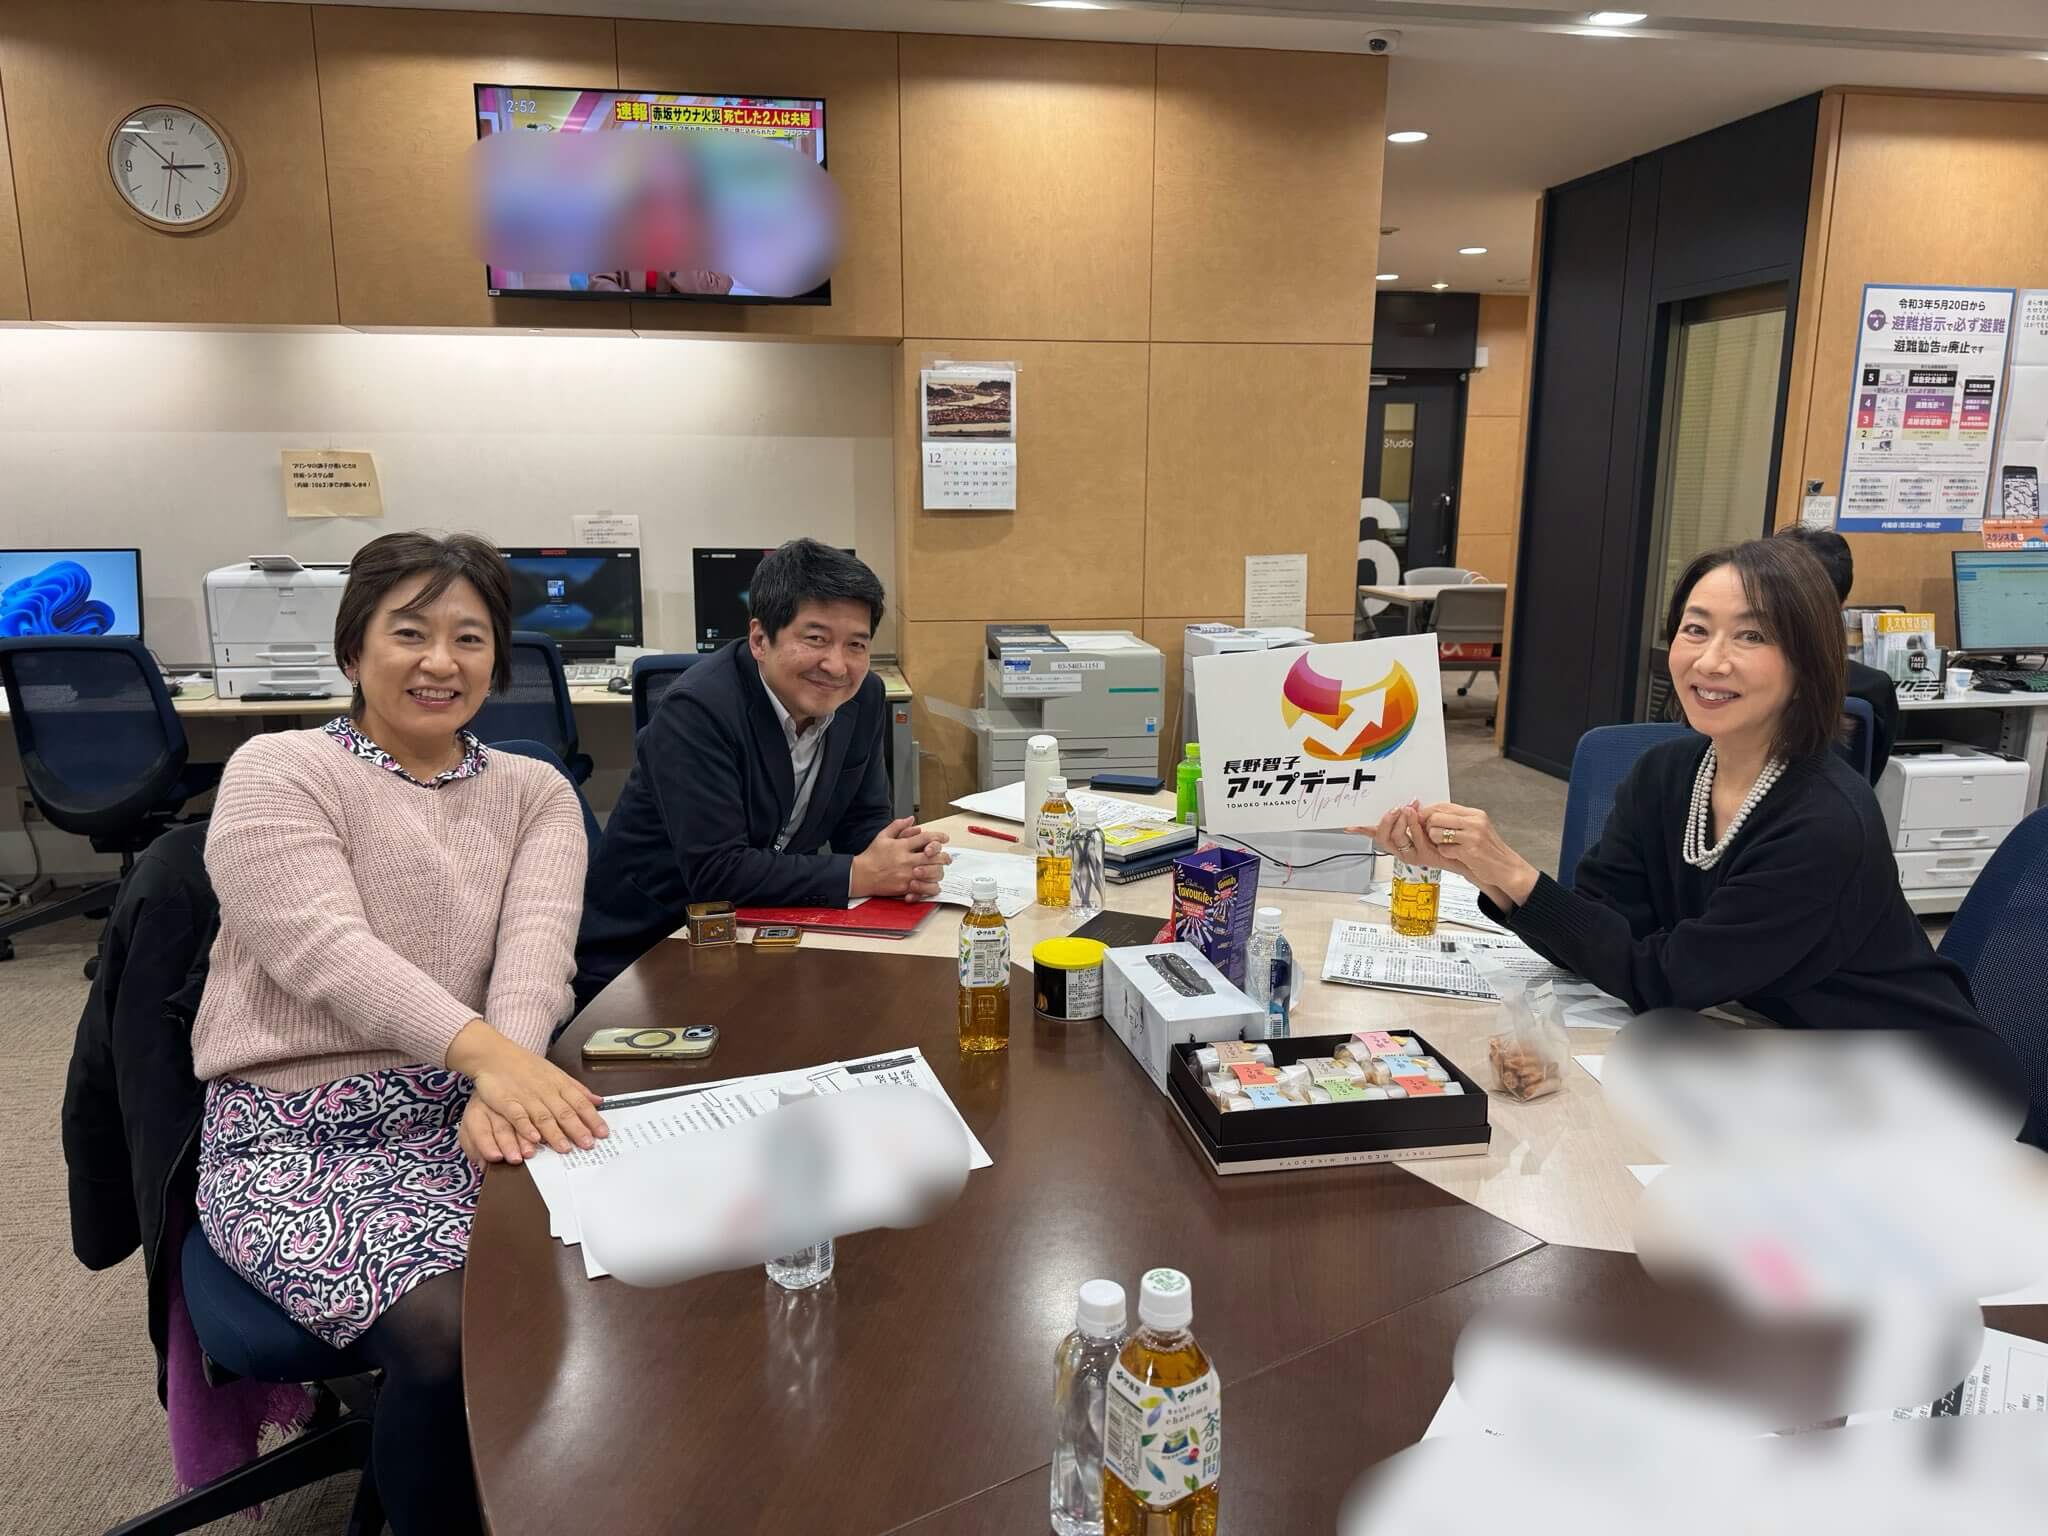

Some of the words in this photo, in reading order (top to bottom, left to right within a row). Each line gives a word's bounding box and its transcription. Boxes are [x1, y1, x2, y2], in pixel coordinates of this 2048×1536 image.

[507, 100, 536, 113] 2:52
[616, 102, 648, 121] 速報
[652, 107, 721, 123] 赤坂サウナ火災
[723, 109, 811, 127] 死亡した2人は夫婦
[164, 118, 174, 131] 12
[125, 160, 132, 172] 9
[213, 162, 221, 174] 3
[174, 203, 182, 216] 6
[1898, 298, 1986, 311] 令和3年5月20日から
[1872, 320, 1879, 329] 4
[1891, 315, 2006, 334] 避難指示で必ず避難
[1893, 339, 1985, 355] 避難勧告は廃止です
[1868, 373, 1874, 382] 5
[1865, 399, 1871, 407] 4
[1863, 415, 1869, 424] 3
[1861, 430, 1867, 438] 2
[1383, 438, 1414, 448] Studio
[929, 452, 942, 463] 12
[1223, 756, 1301, 775] 長野智子
[1227, 768, 1376, 799] アップデート
[1176, 882, 1213, 906] Favourites
[1201, 1408, 1219, 1479] 茶の間
